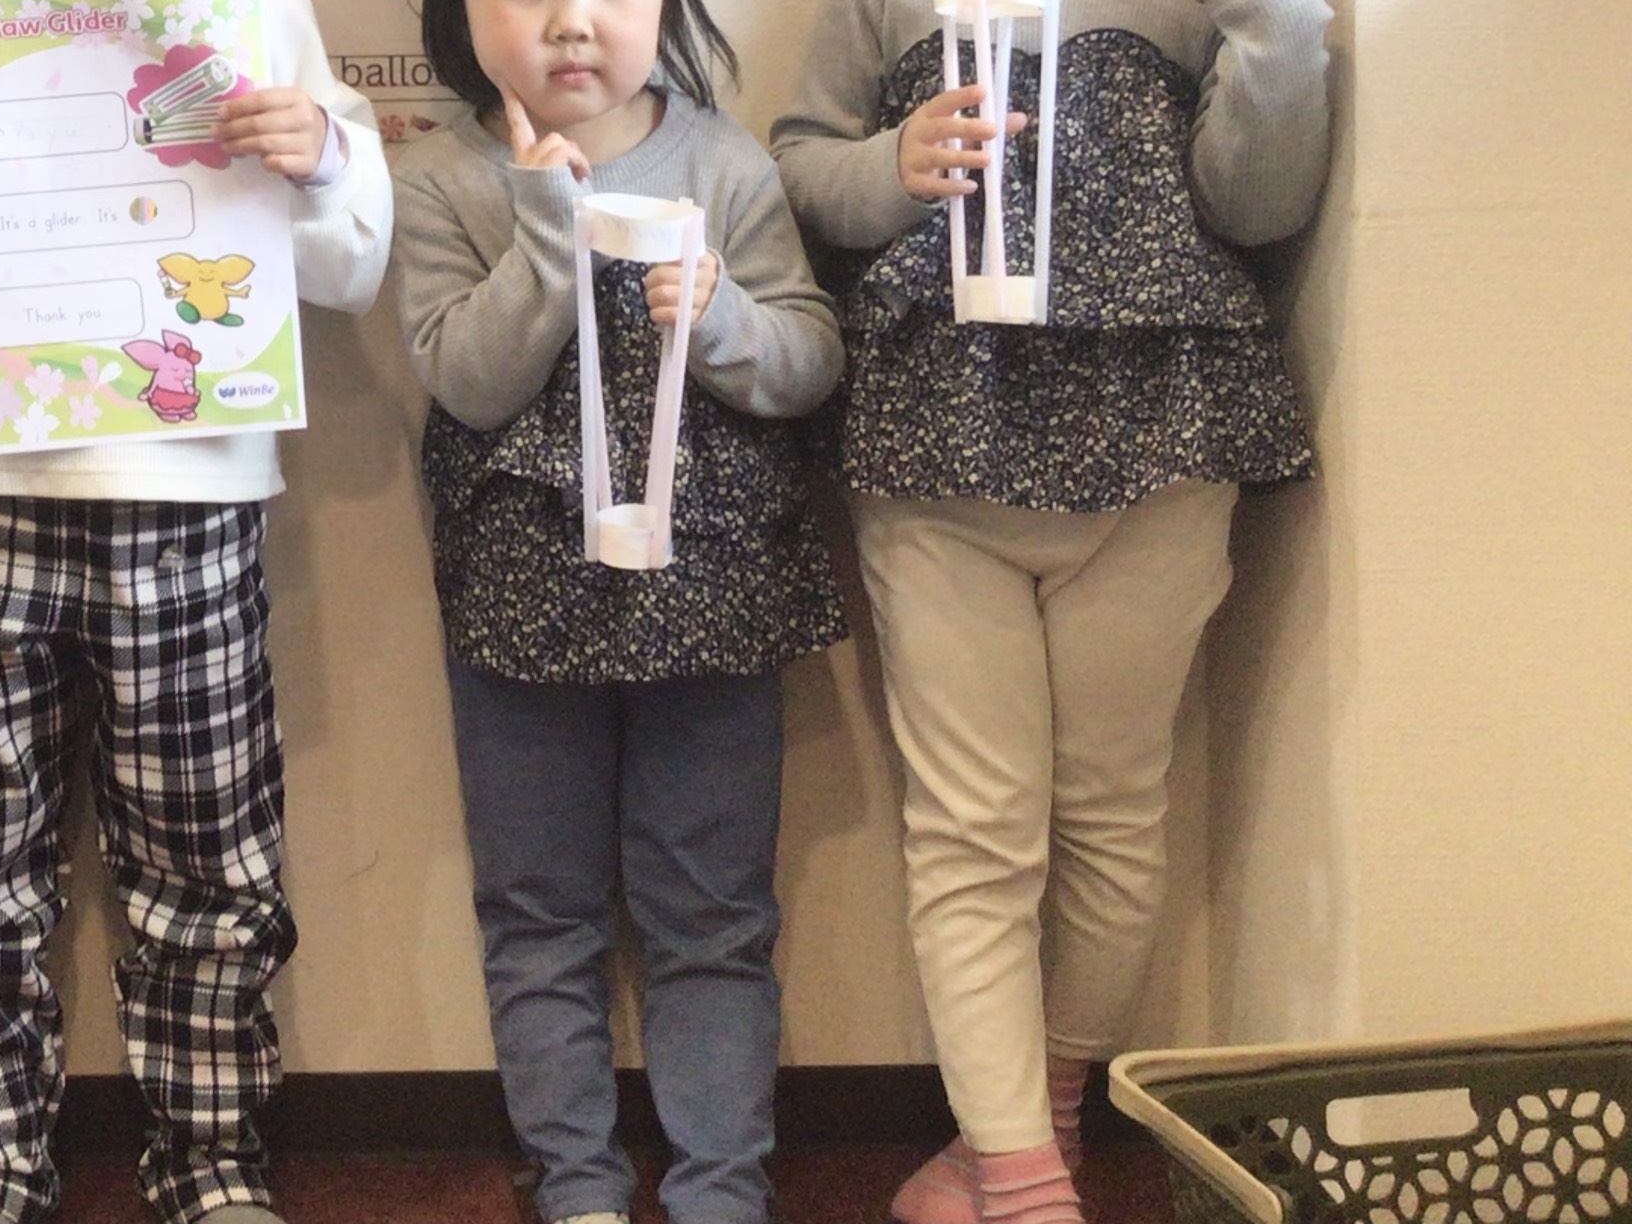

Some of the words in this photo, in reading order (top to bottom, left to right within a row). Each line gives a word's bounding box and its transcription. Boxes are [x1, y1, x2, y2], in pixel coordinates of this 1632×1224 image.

[47, 9, 128, 35] Glider
[341, 55, 448, 88] ballo
[23, 306, 68, 325] Thank
[238, 383, 275, 398] WinBe
